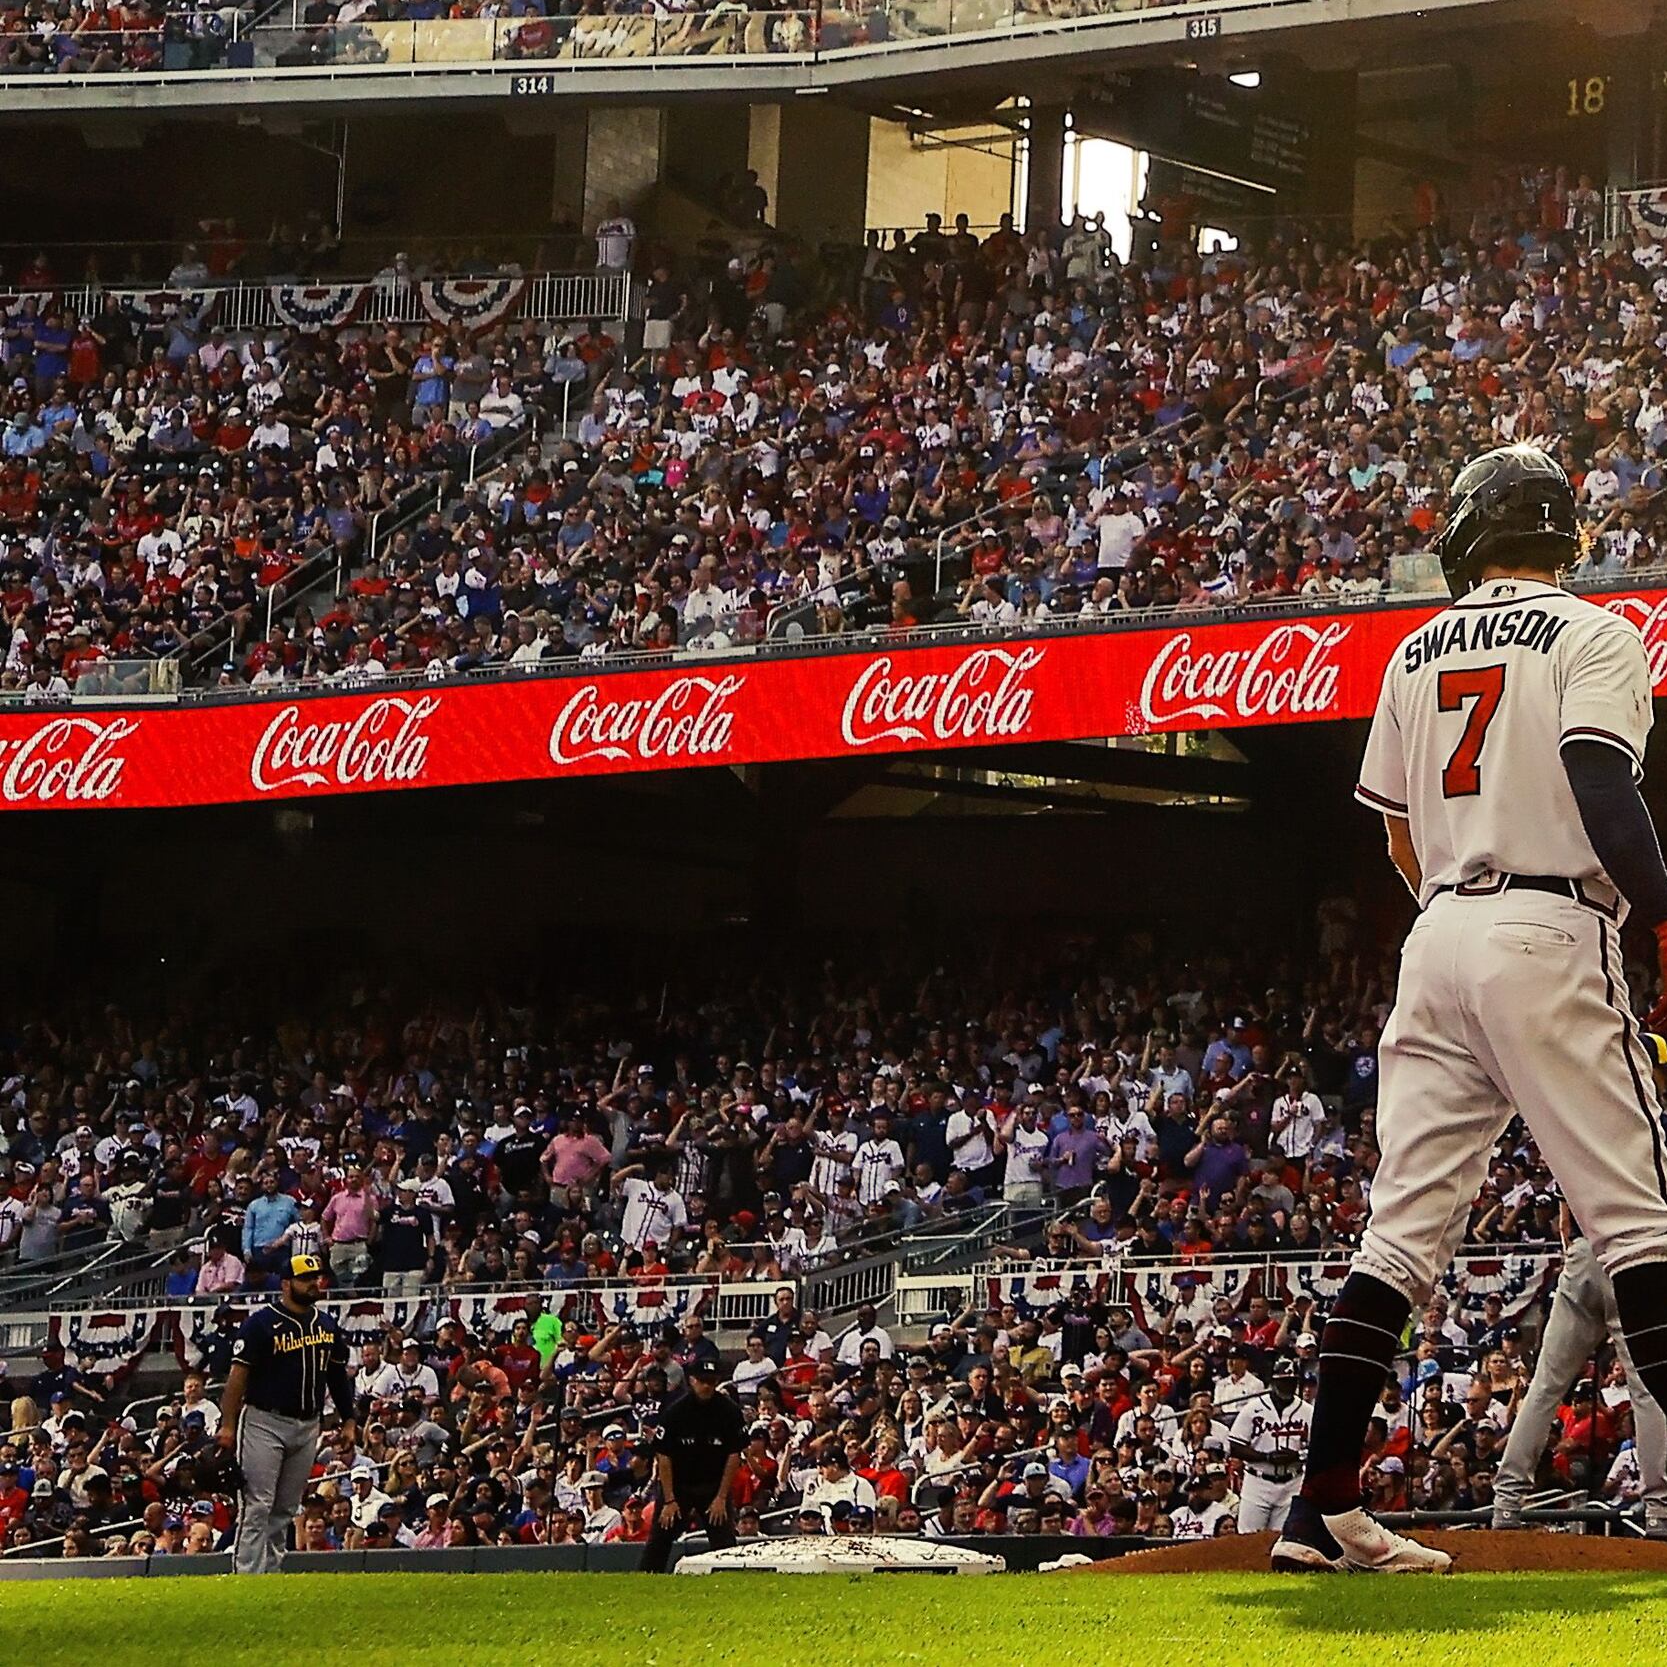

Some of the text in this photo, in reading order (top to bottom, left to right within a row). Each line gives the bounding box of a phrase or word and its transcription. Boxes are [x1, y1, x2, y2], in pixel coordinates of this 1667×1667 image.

[1189, 18, 1217, 39] 315
[517, 76, 549, 95] 314
[1541, 503, 1550, 519] 7
[1404, 609, 1570, 674] SWANSON
[1437, 662, 1508, 800] 7
